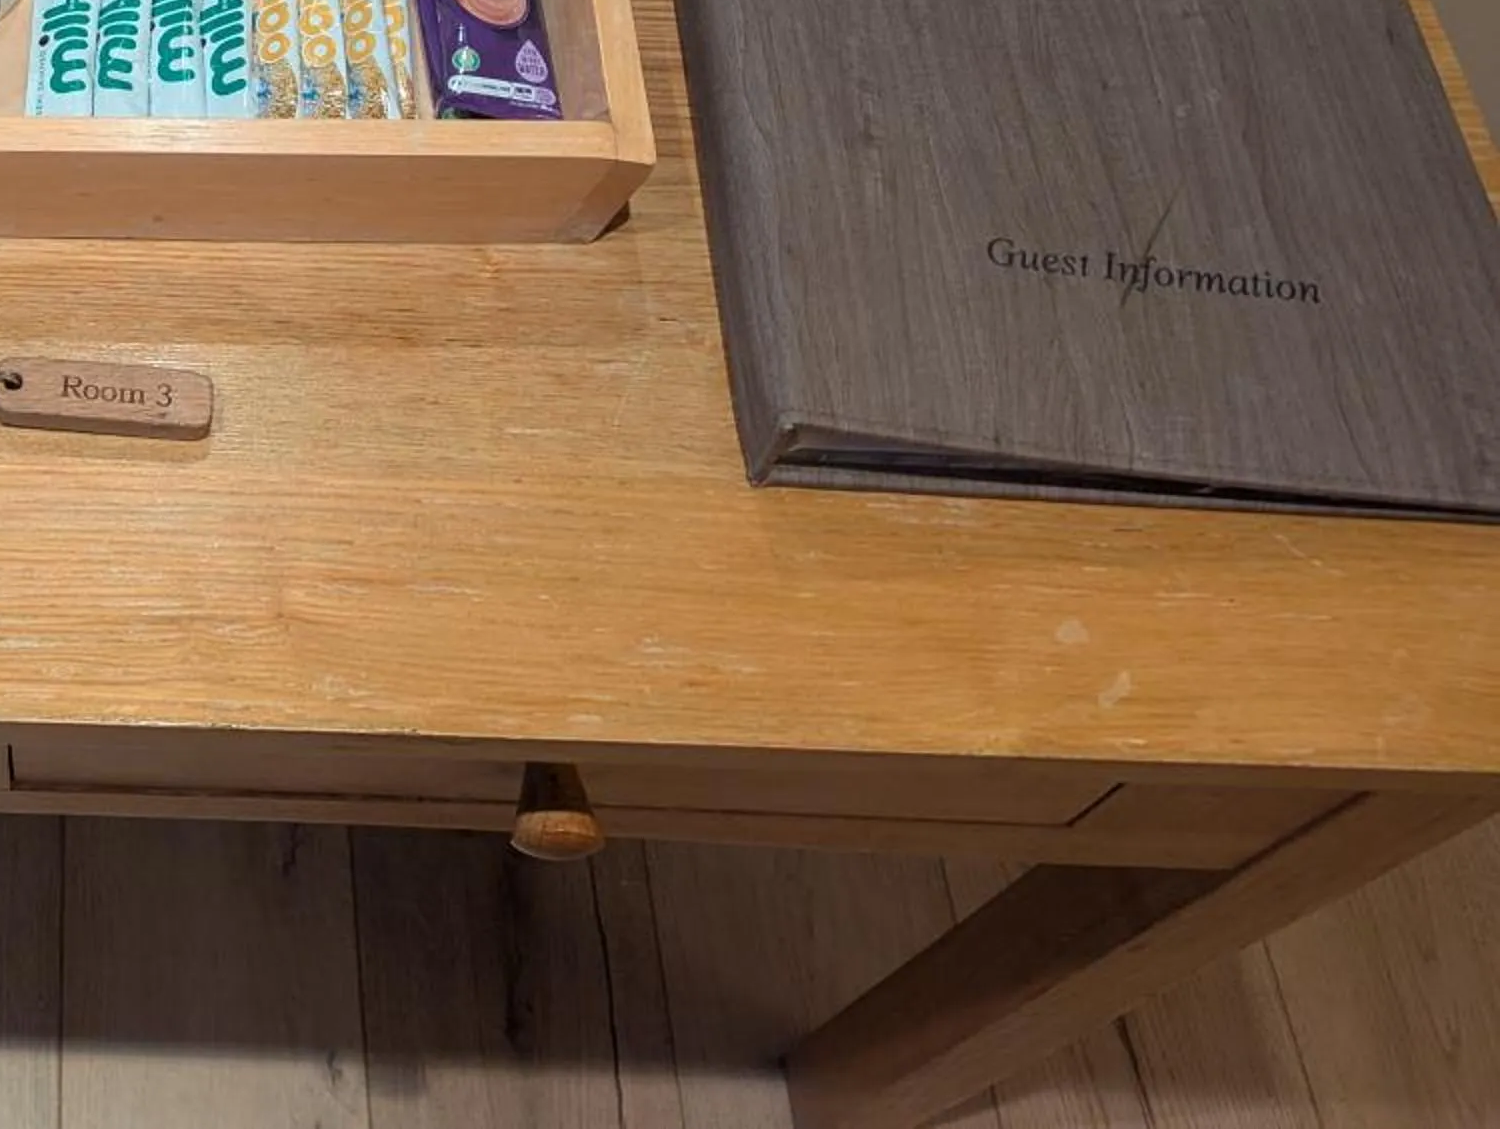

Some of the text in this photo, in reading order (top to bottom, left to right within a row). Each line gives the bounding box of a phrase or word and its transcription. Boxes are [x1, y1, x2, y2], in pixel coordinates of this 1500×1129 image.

[987, 237, 1320, 304] Guest Information
[60, 374, 173, 407] Room 3
